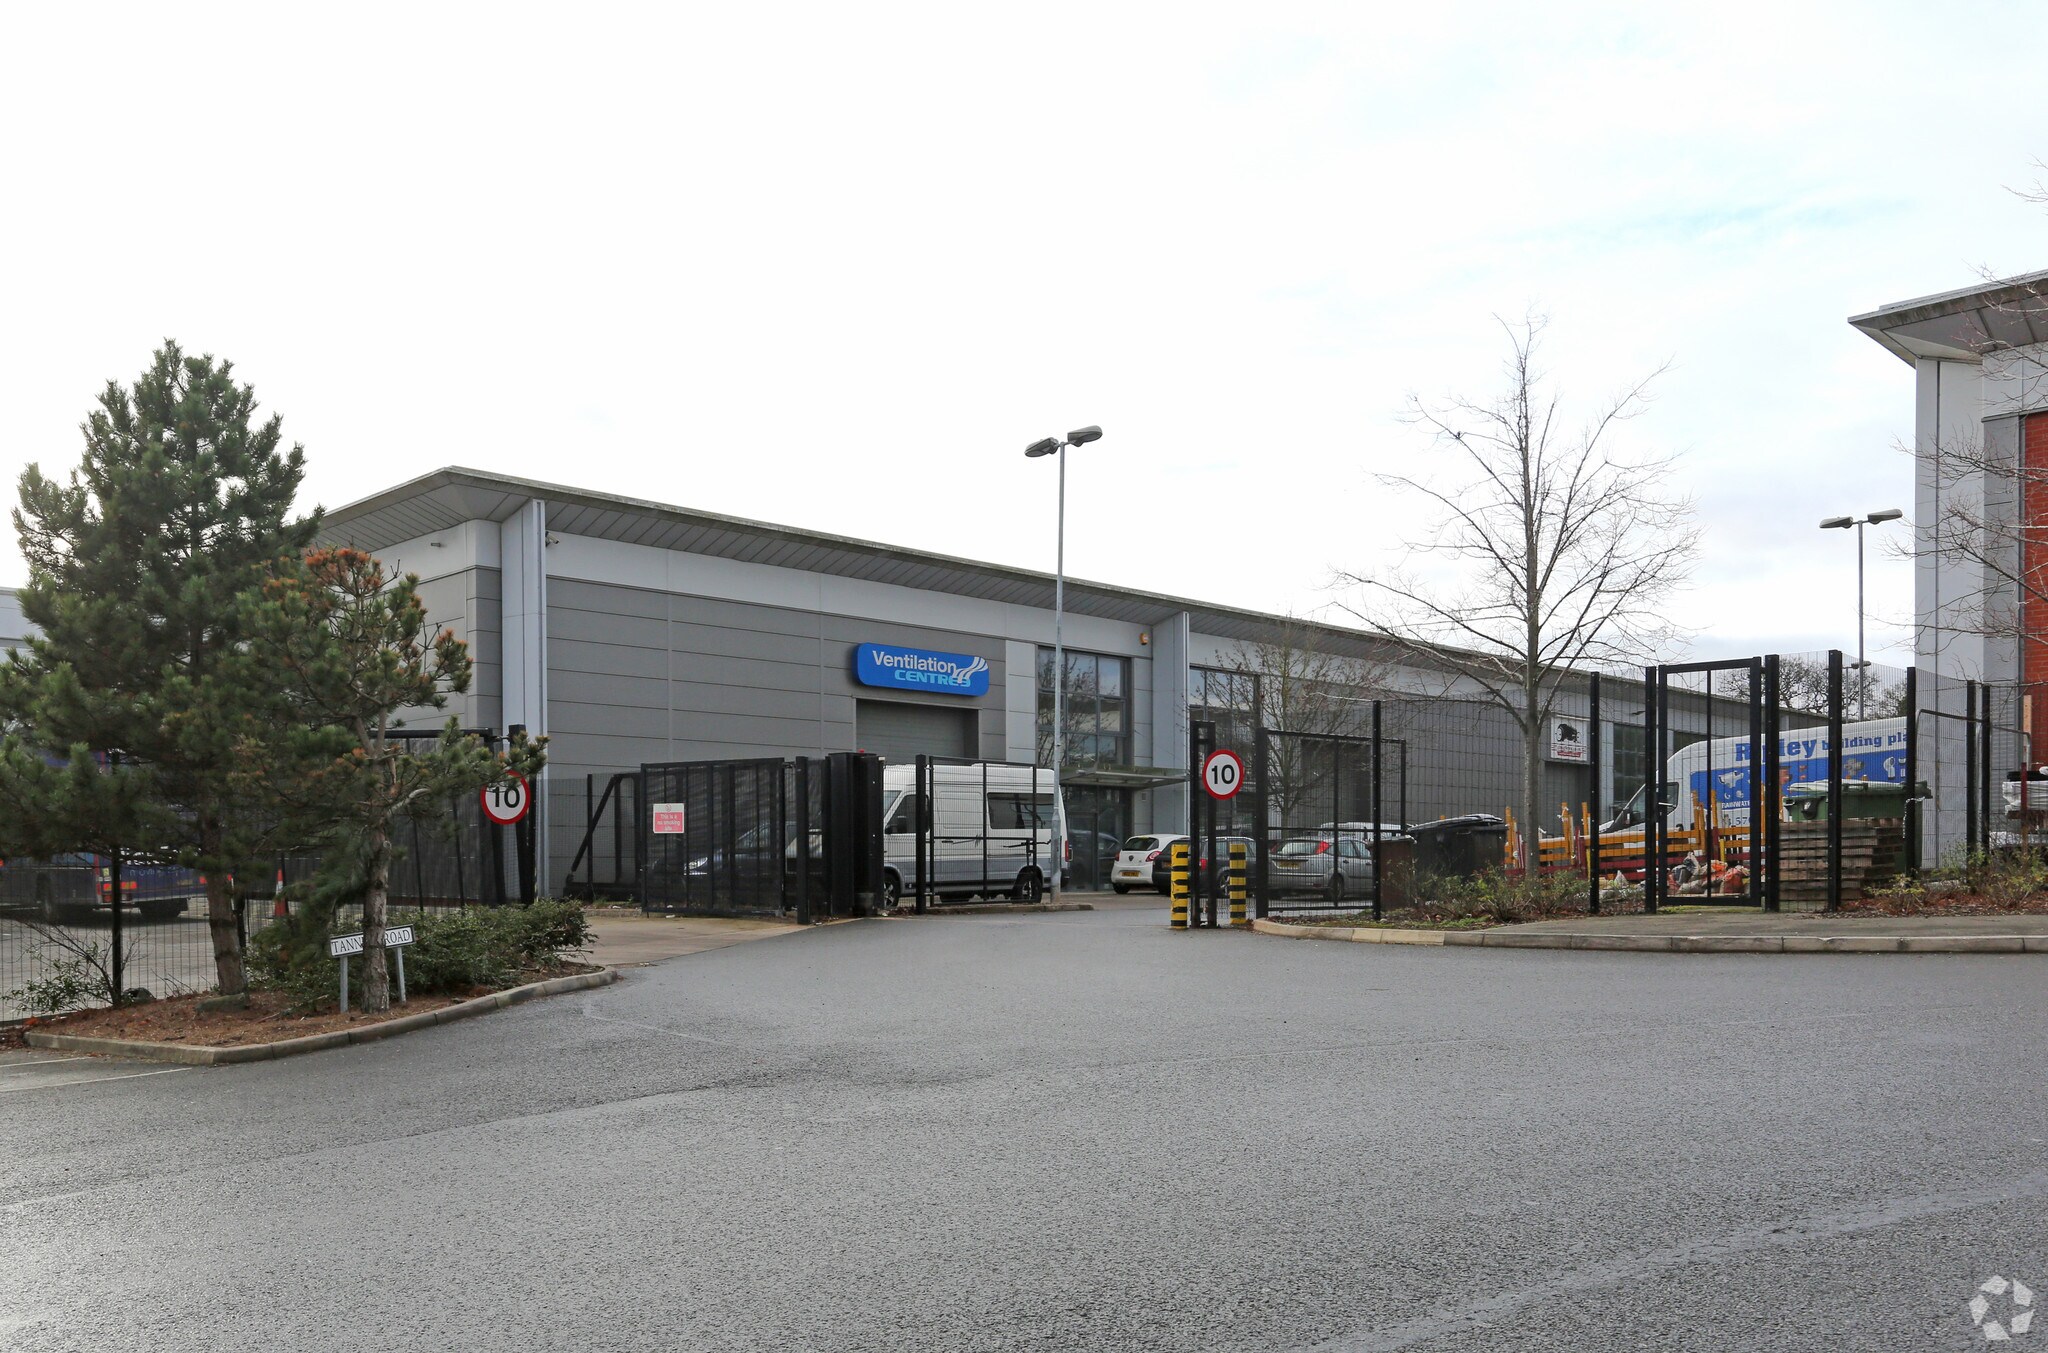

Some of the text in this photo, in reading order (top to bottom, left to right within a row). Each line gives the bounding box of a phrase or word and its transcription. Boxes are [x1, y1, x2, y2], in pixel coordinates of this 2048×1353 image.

[872, 650, 957, 674] Ventilation
[1212, 764, 1235, 784] 10
[493, 787, 520, 808] 10
[385, 929, 410, 944] ROAD
